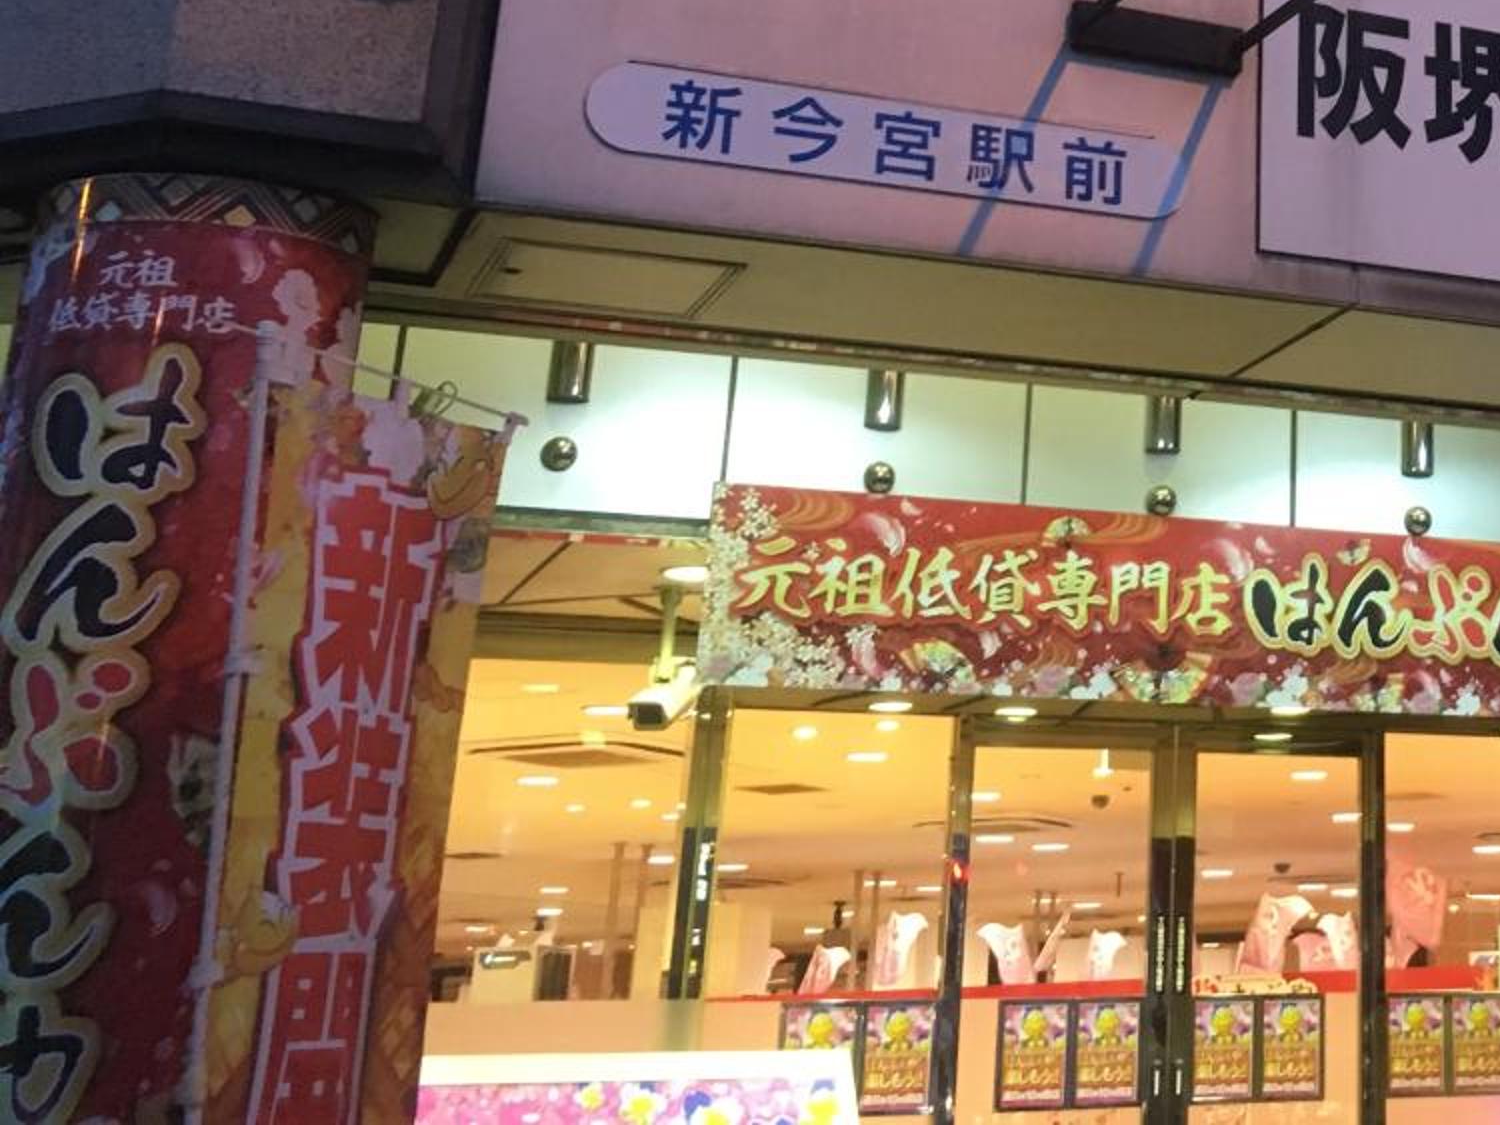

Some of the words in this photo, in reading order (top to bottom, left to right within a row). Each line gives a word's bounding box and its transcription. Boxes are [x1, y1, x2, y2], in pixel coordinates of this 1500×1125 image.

[661, 79, 1128, 206] 新今宮駅前
[98, 248, 179, 289] 元祖
